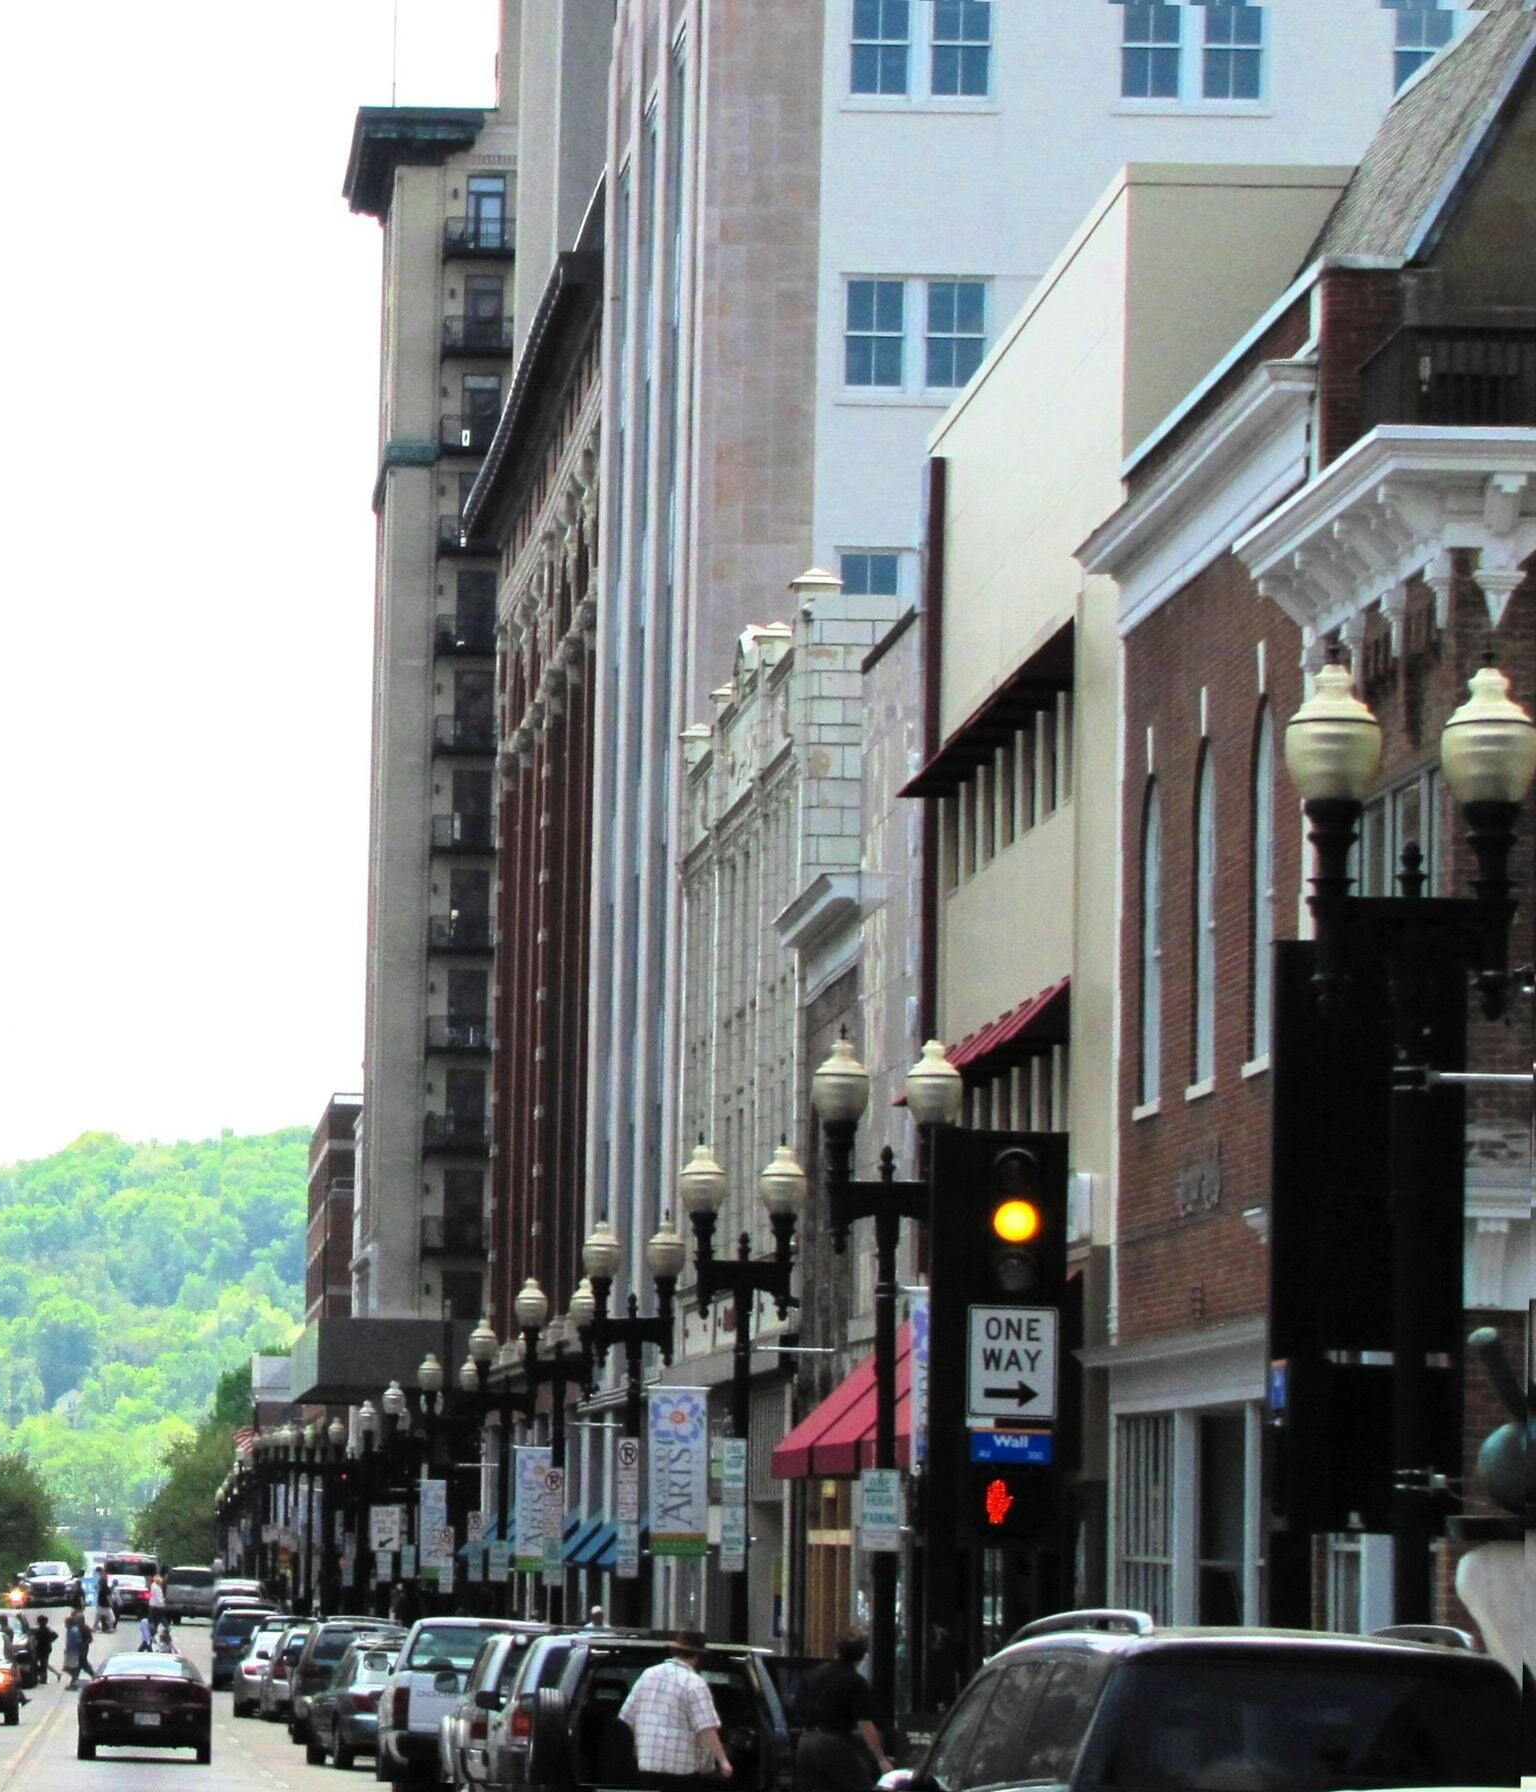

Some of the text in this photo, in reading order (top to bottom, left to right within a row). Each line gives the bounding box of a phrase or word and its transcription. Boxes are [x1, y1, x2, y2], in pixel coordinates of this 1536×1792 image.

[985, 1316, 1041, 1342] ONE
[982, 1347, 1042, 1373] WAY
[992, 1434, 1029, 1449] Wall
[662, 1448, 693, 1527] ARTS
